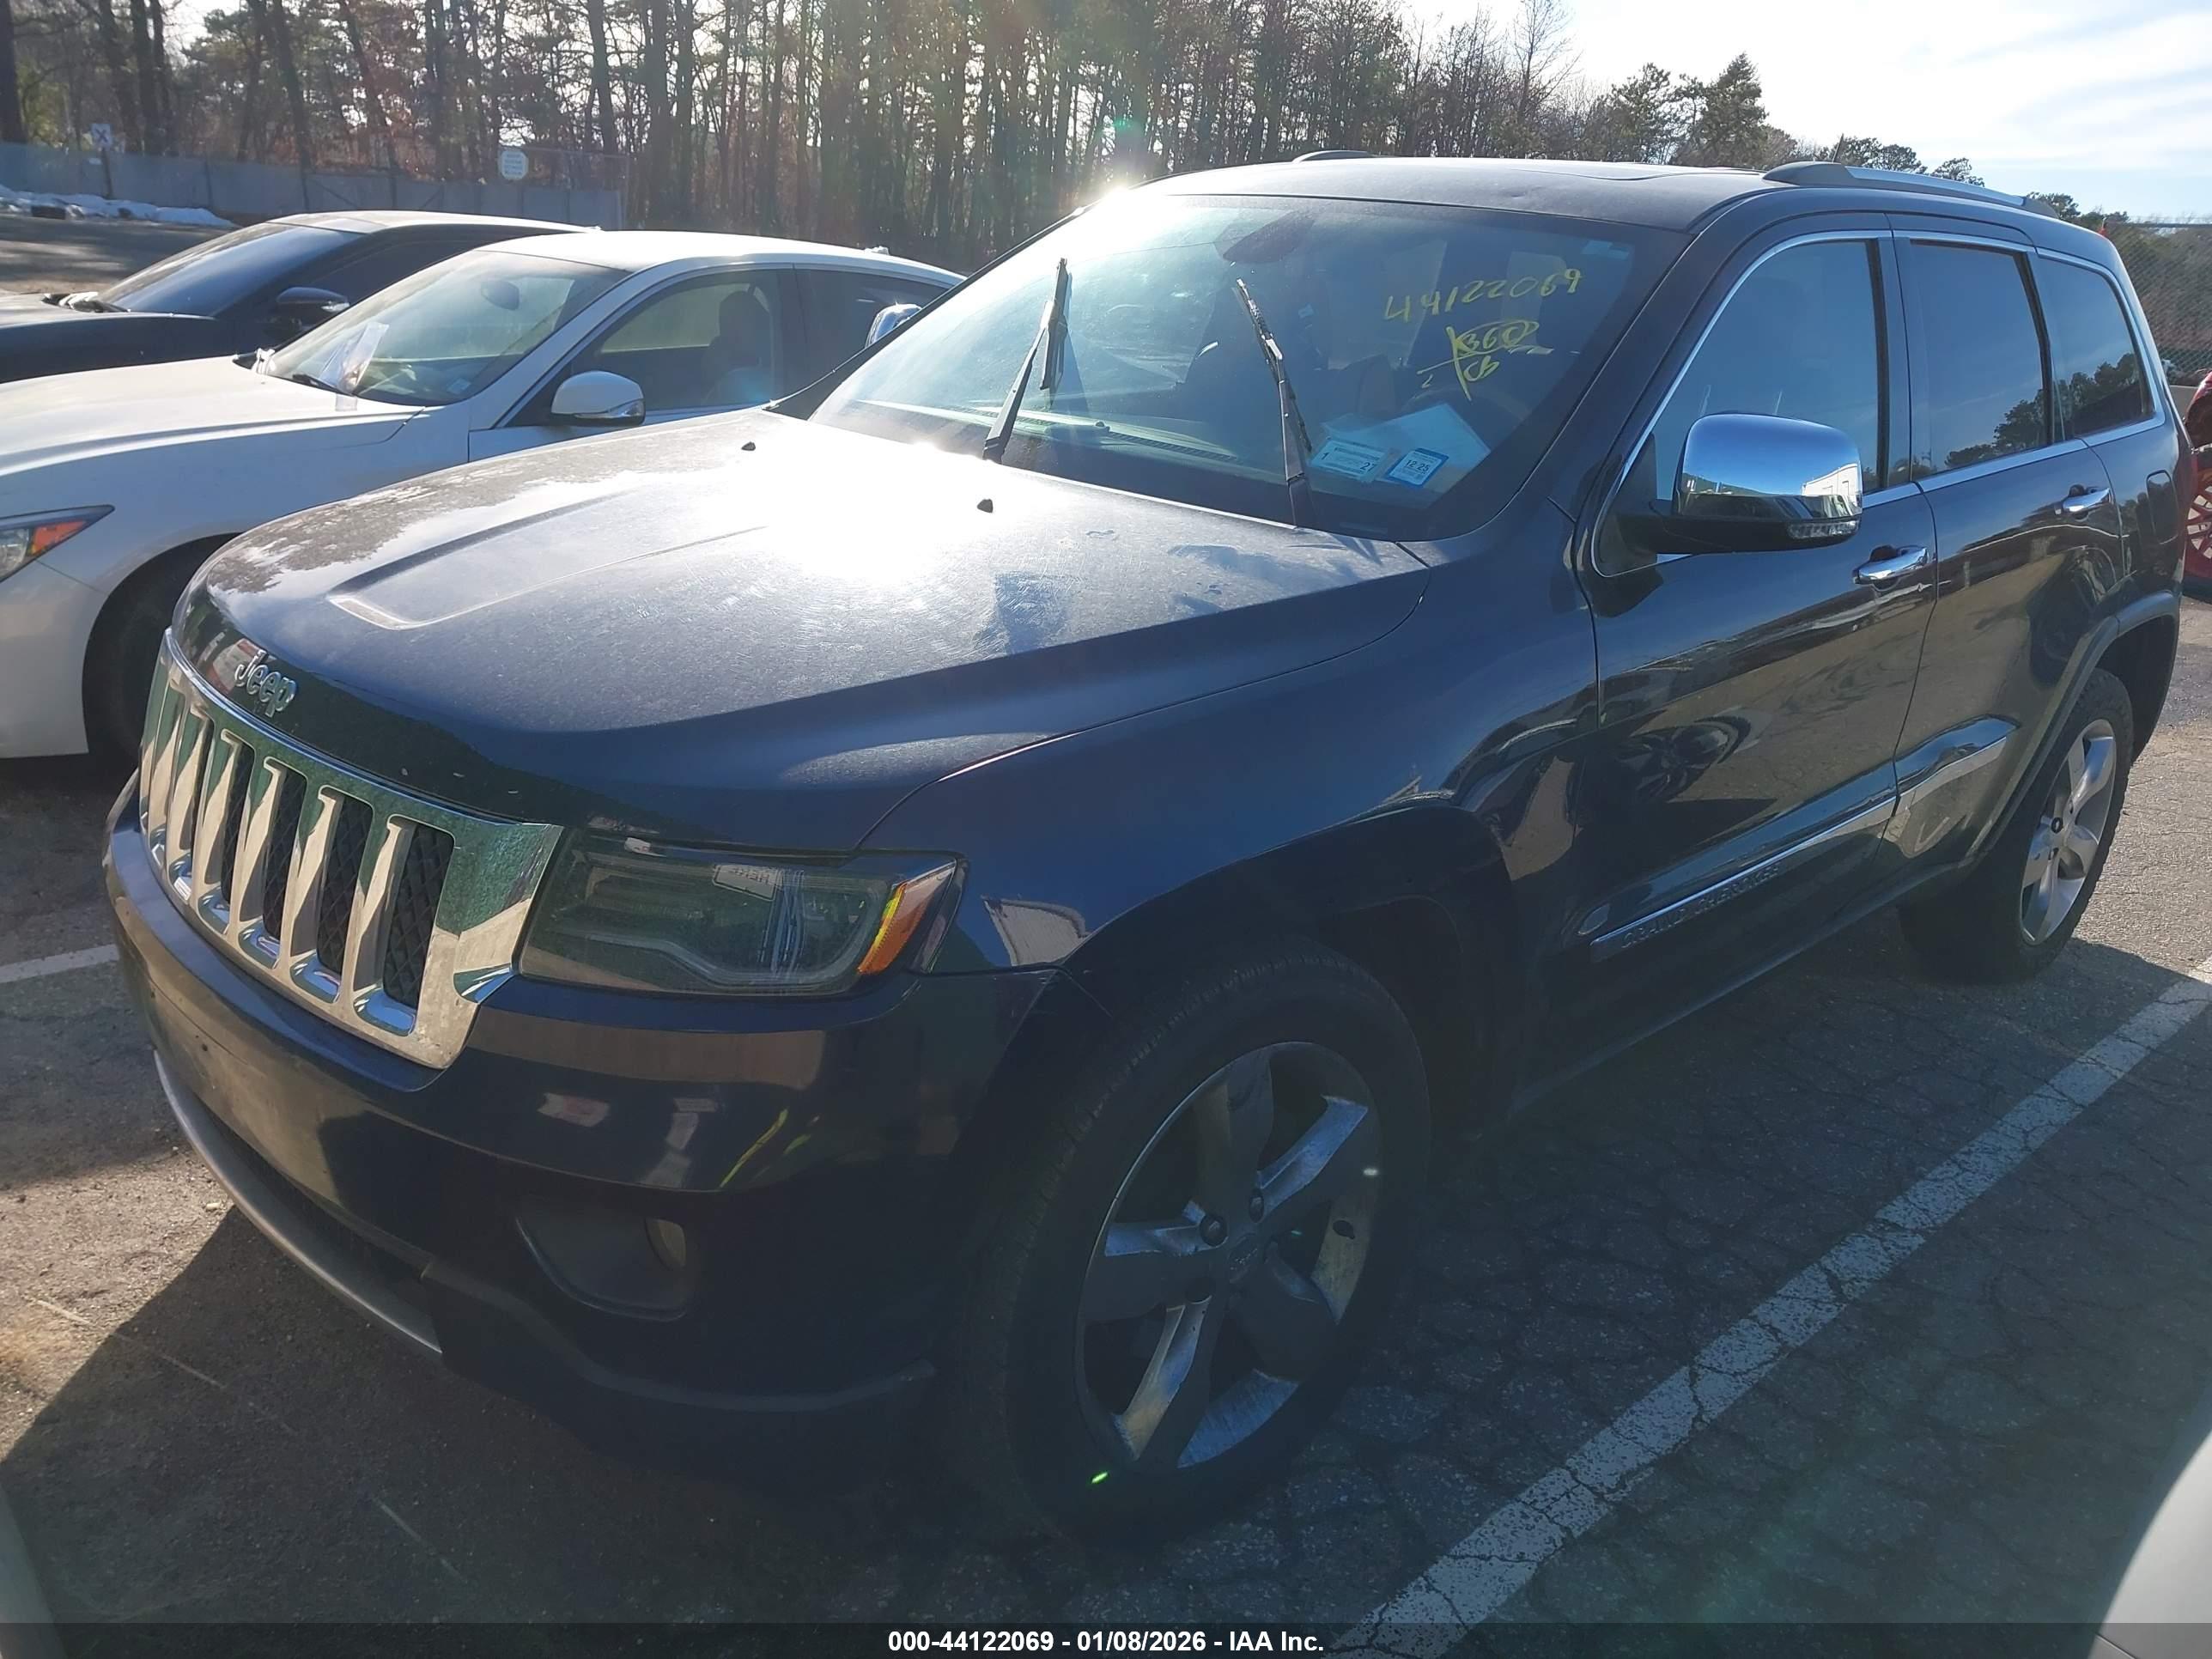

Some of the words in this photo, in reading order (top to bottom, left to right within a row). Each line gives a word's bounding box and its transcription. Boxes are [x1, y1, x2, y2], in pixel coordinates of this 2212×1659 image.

[1384, 268, 1582, 323] 44122069
[1406, 459, 1417, 470] 12
[1417, 462, 1431, 472] 25
[234, 650, 296, 718] Jeep
